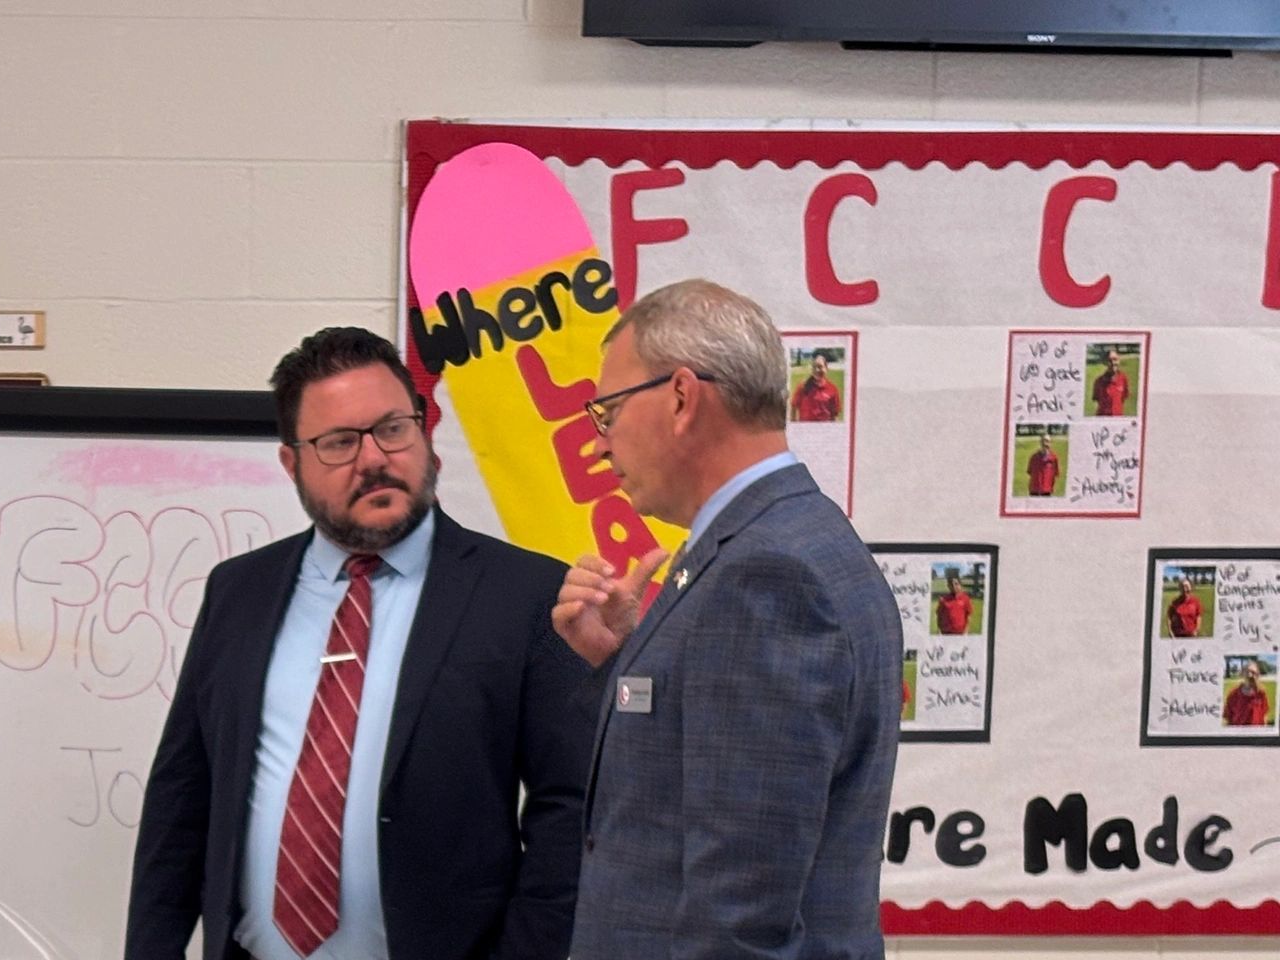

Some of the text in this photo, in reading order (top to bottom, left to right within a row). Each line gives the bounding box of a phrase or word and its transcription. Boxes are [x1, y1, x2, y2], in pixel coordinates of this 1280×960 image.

[410, 257, 620, 374] Where
[1029, 340, 1068, 358] VP of
[1092, 426, 1128, 448] VP of
[882, 792, 1234, 875] re Made
